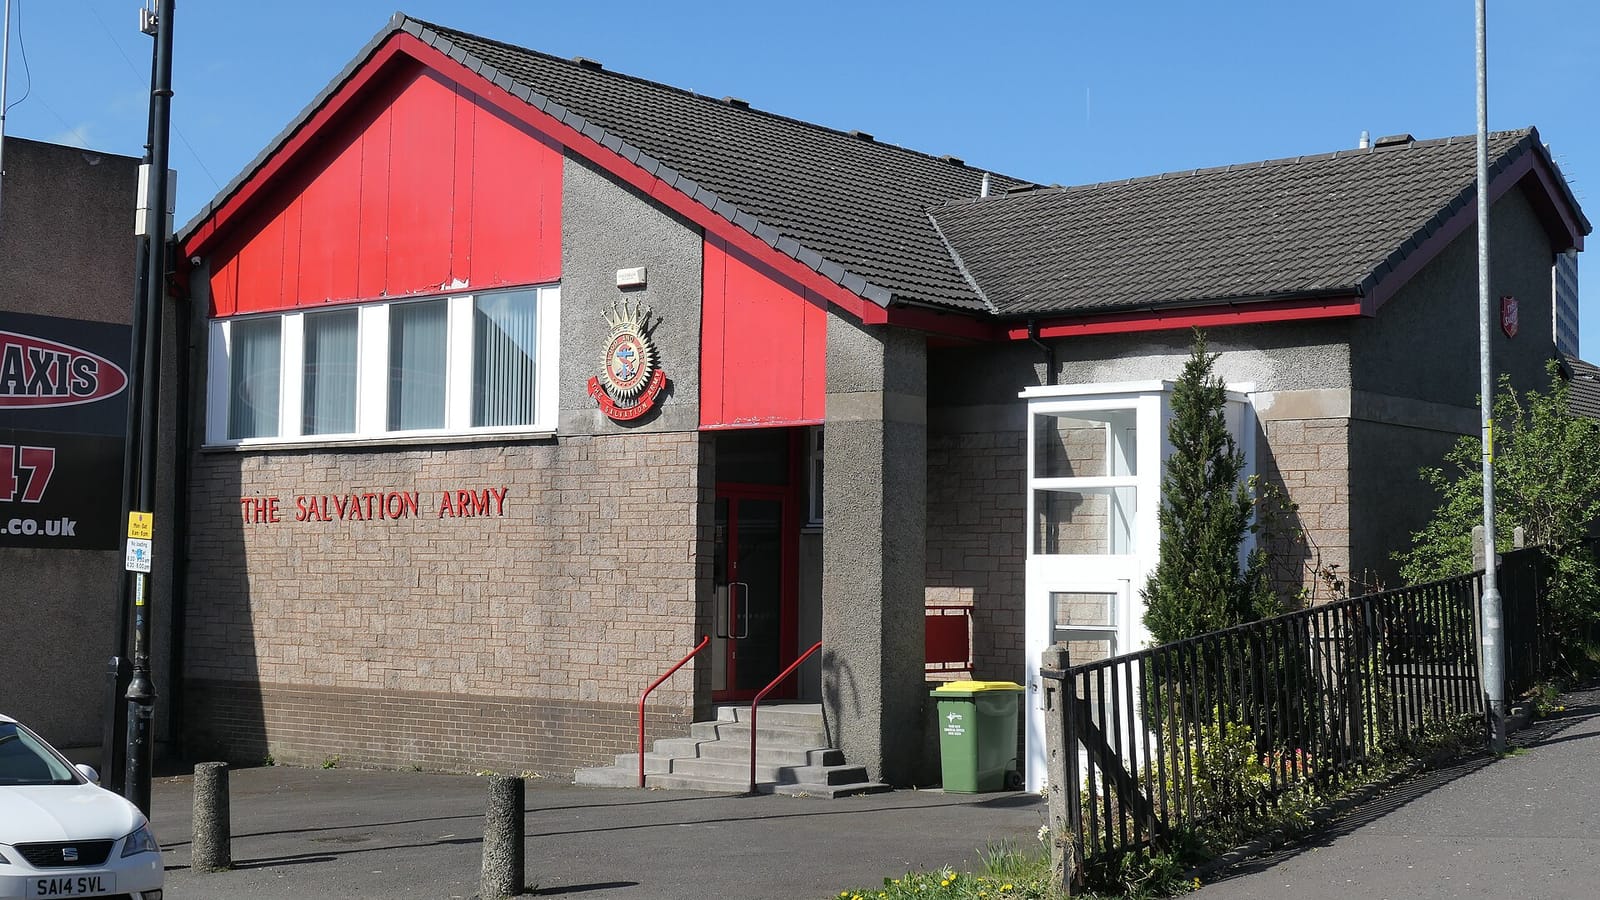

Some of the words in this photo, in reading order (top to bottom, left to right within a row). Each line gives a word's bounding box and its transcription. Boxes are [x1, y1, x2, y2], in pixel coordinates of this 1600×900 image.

[591, 381, 603, 398] THE
[605, 403, 648, 417] SALVATION
[647, 372, 660, 395] ARMY
[240, 497, 280, 524] THE
[296, 491, 419, 522] SALVATION
[438, 485, 508, 519] ARMY
[0, 517, 76, 537] .co.uk
[37, 878, 73, 895] SA14
[77, 876, 106, 893] SVL
